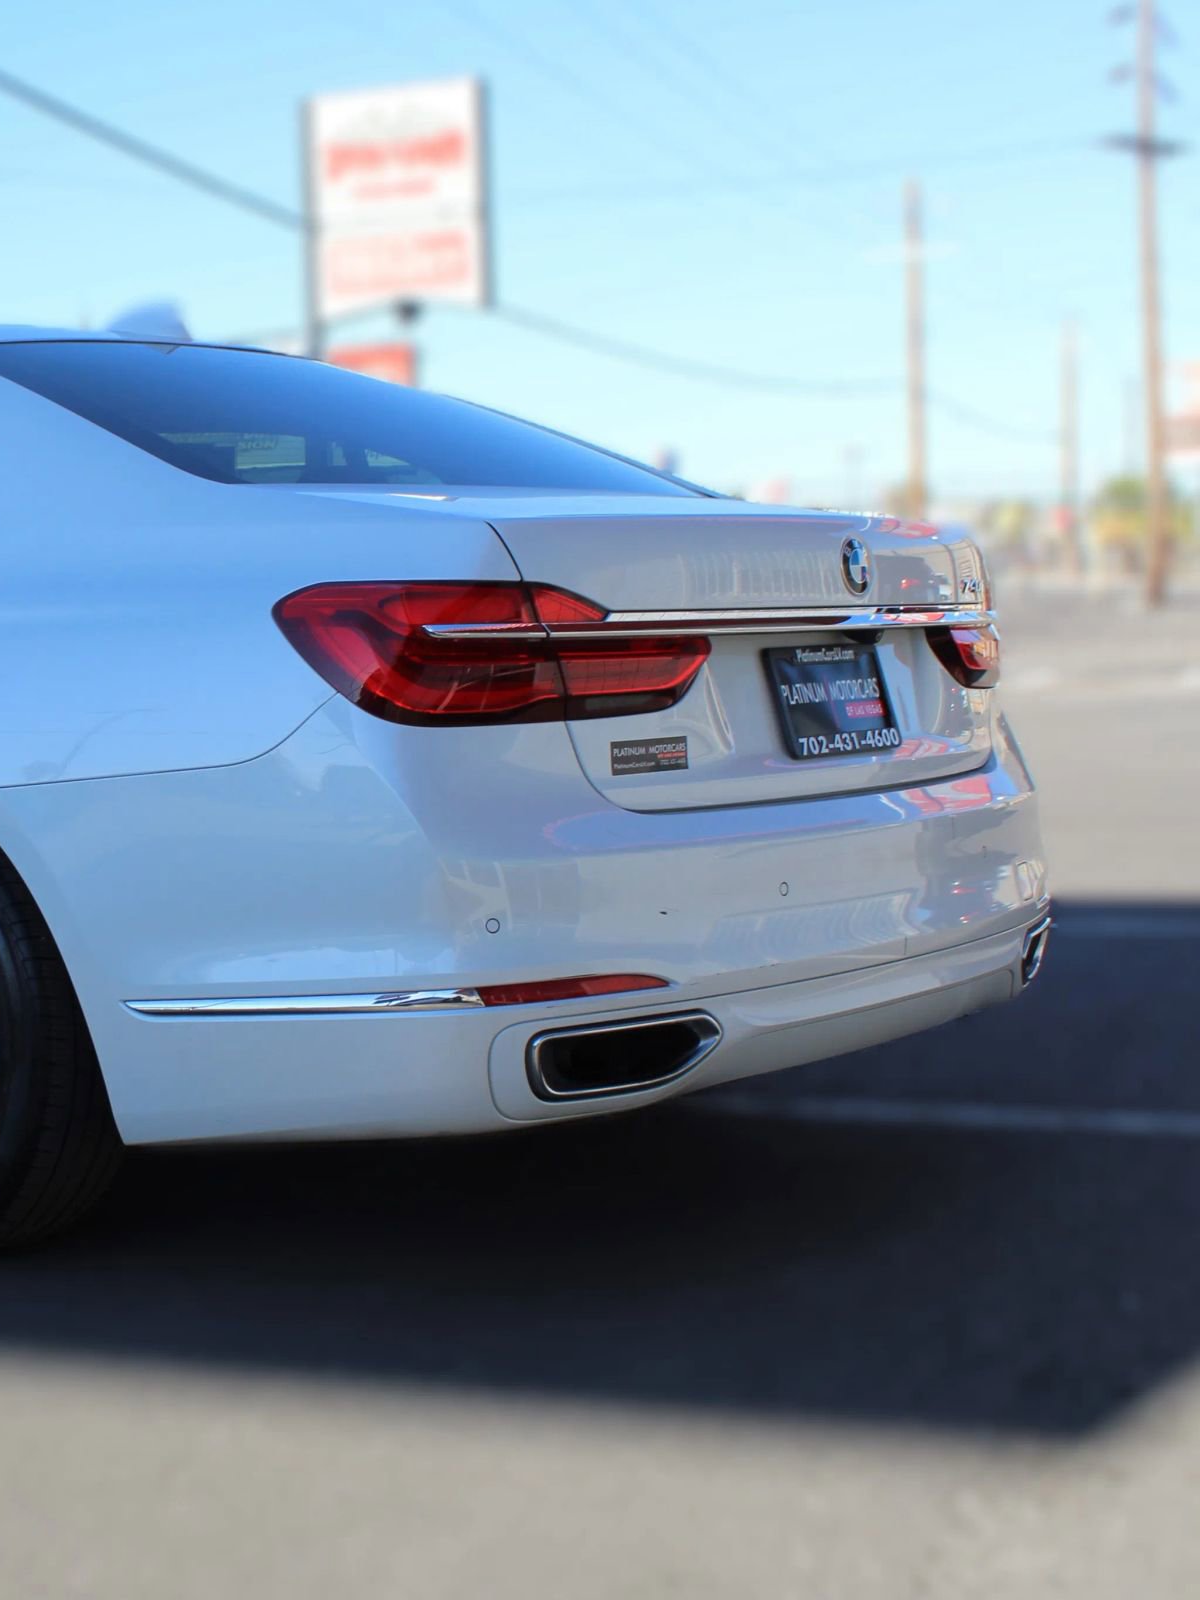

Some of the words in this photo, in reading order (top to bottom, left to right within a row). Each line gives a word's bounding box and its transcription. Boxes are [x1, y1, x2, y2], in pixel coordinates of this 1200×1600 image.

[781, 682, 828, 705] PLATINUM
[829, 677, 880, 701] MOTORCARS
[613, 746, 646, 757] PLATINUM
[649, 742, 686, 754] MOTORCARS
[799, 728, 900, 756] 702-431-4600
